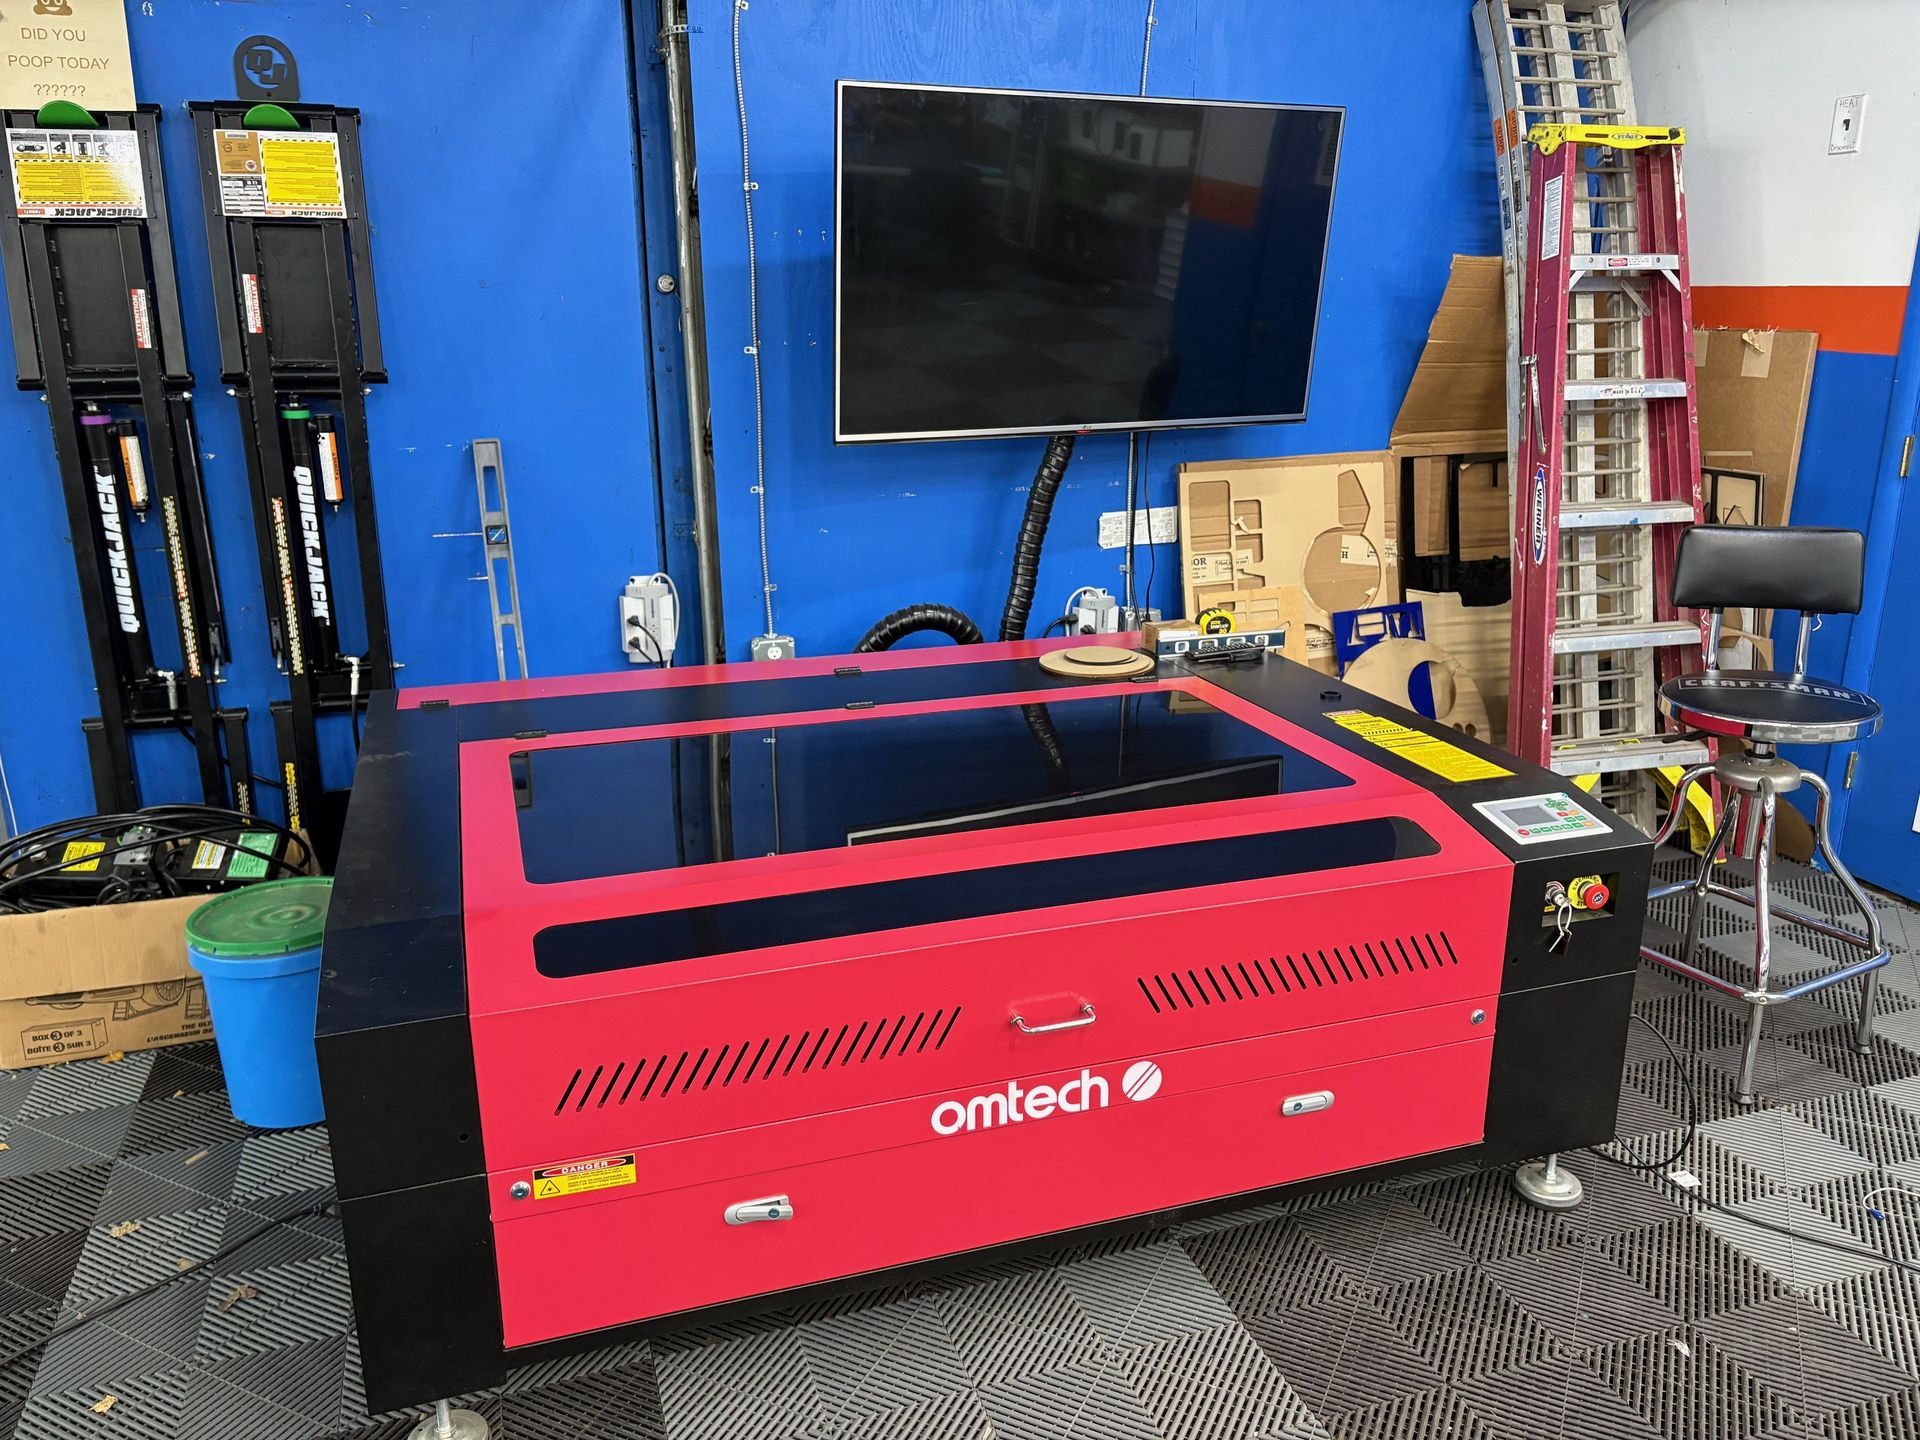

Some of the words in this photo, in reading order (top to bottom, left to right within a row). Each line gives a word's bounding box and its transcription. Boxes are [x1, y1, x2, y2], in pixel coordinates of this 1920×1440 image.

[20, 27, 48, 40] DID
[51, 28, 86, 42] YOU
[7, 54, 54, 68] POOP
[56, 56, 110, 70] TODAY
[33, 83, 86, 97] ??????
[54, 207, 143, 217] QUICKJACK
[1535, 488, 1543, 543] WERNER
[292, 465, 330, 619] QUICKJACK
[94, 472, 141, 633] QUICKJACK
[1684, 679, 1851, 699] CRAFTSMAN
[31, 1034, 49, 1042] BOX
[66, 1041, 85, 1049] SUR
[930, 1068, 1110, 1135] omtech
[561, 1161, 609, 1175] DANGER
